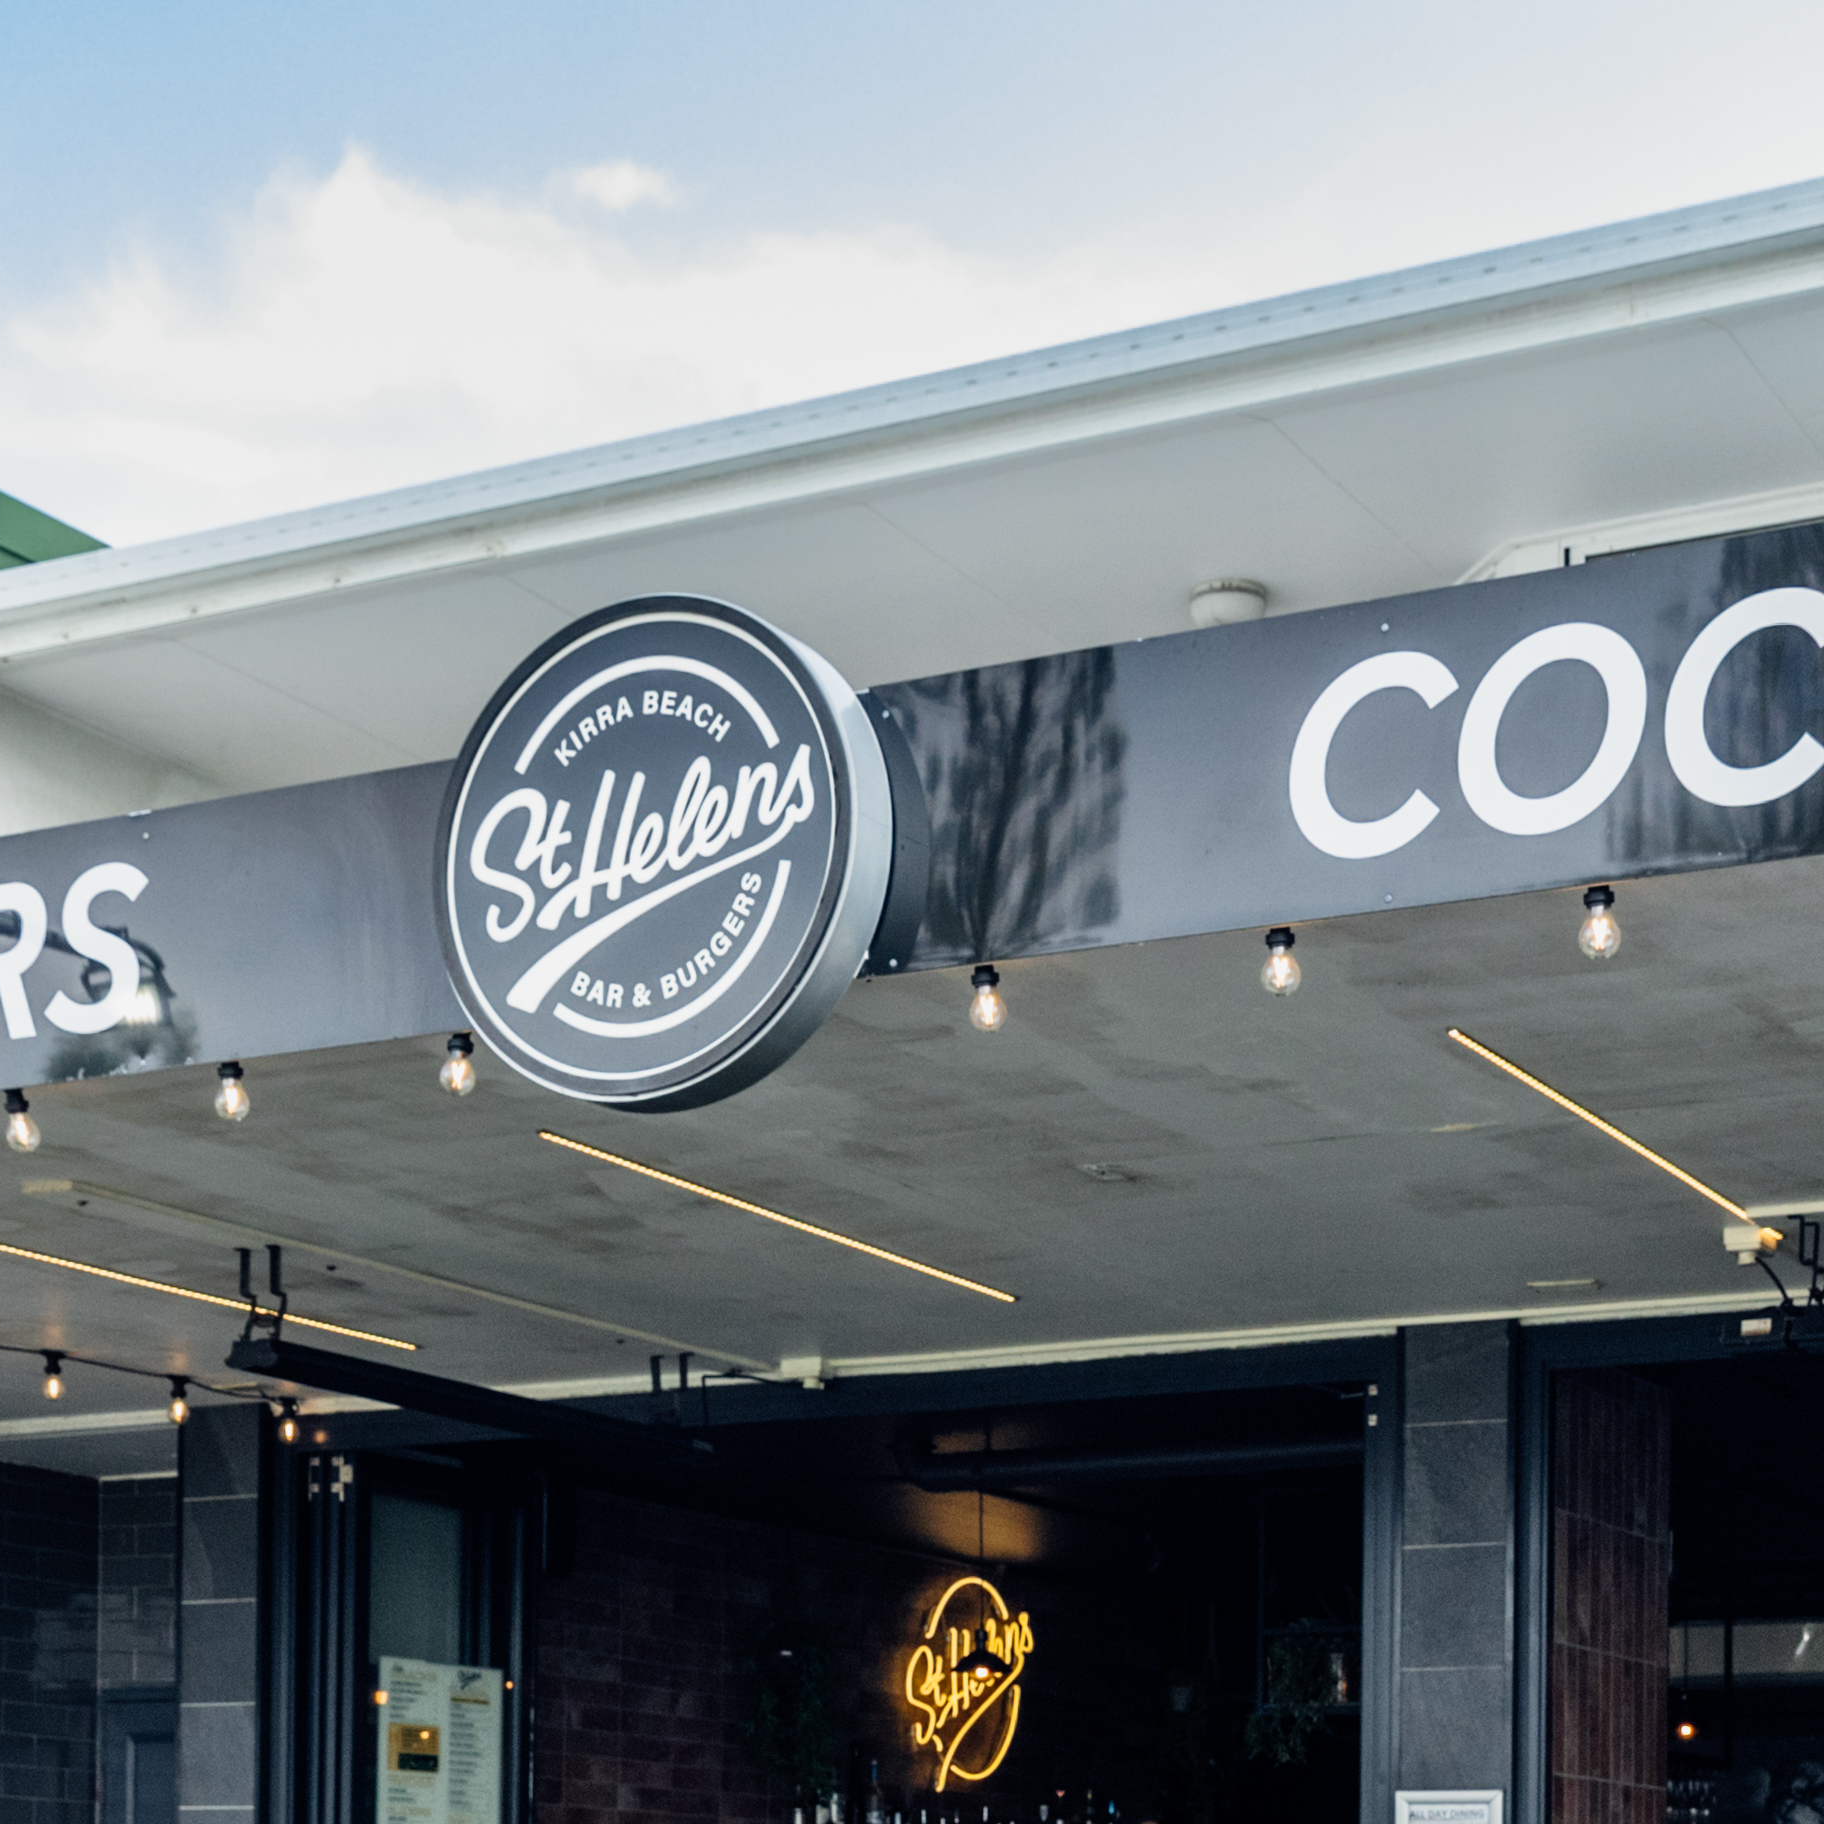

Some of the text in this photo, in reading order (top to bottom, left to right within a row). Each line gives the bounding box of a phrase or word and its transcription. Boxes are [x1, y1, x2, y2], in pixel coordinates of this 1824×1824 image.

[553, 690, 732, 767] KIRRA BEACH
[570, 871, 763, 1008] BAR & BURGERS
[1409, 1809, 1484, 1819] ALL DAY DINING
